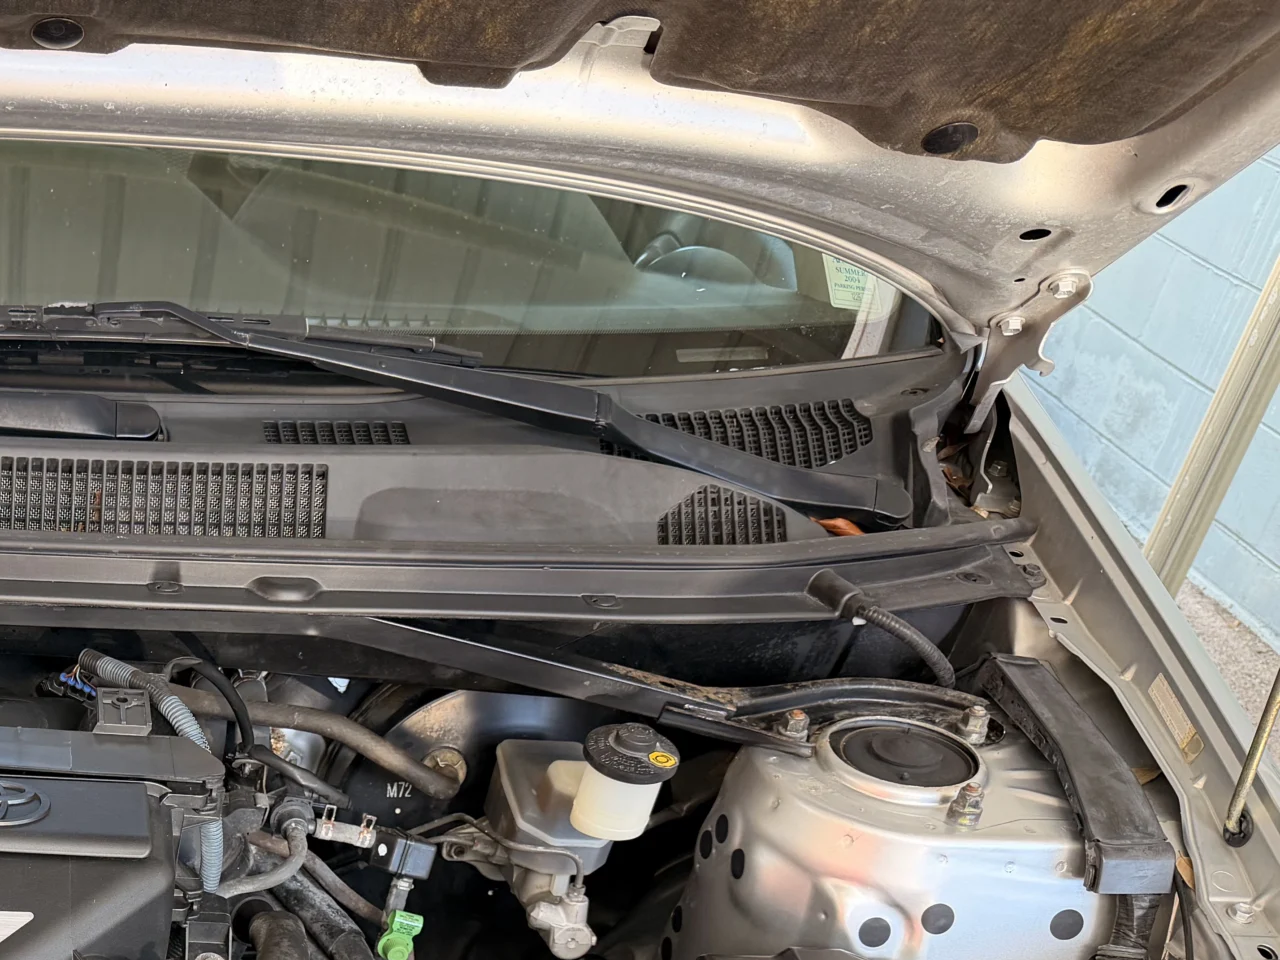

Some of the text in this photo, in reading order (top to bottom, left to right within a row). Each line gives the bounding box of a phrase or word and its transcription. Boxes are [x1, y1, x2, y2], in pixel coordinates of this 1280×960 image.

[835, 267, 866, 277] SUMMER
[834, 283, 855, 291] PARKING
[386, 782, 412, 798] M72
